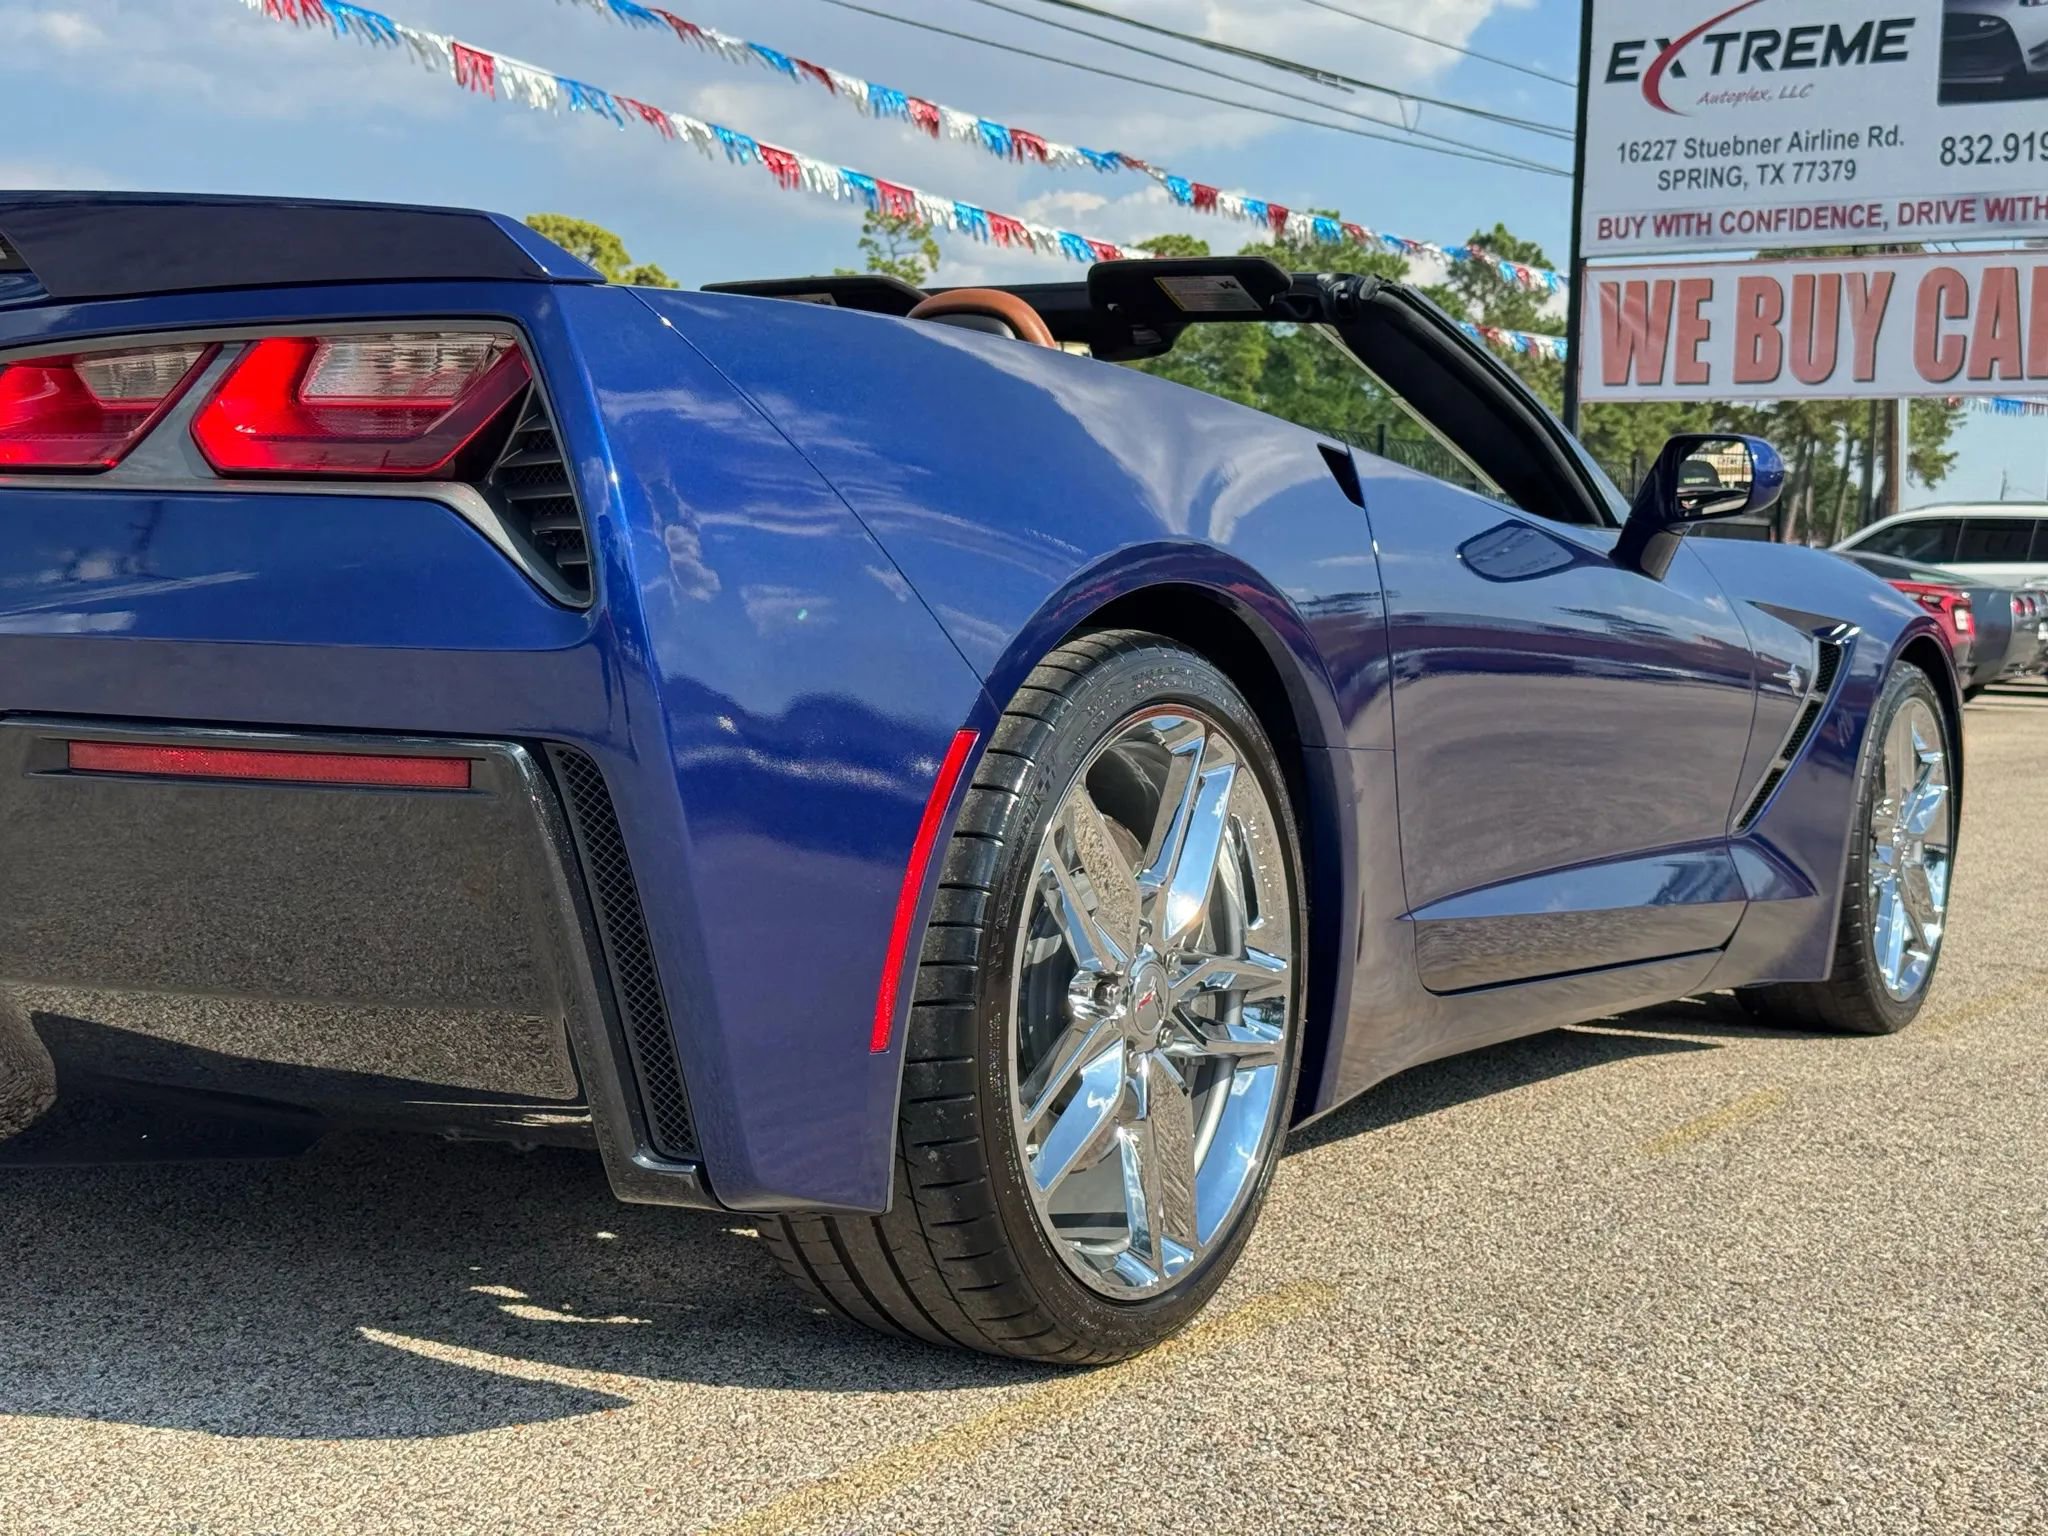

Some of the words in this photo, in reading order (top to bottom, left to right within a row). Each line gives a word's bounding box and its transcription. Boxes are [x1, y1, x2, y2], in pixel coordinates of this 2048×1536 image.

[1604, 17, 1917, 84] EXTREME
[1696, 85, 1773, 108] Autoplex,
[1778, 83, 1815, 99] LLC
[1617, 139, 1677, 164] 16227
[1683, 136, 1783, 160] Stuebner
[1786, 128, 1861, 153] Airline
[1867, 125, 1905, 148] Rd.
[1657, 166, 1749, 191] SPRING,
[1757, 163, 1785, 186] TX
[1792, 159, 1857, 184] 77379
[1598, 216, 1647, 241] BUY
[1653, 212, 1713, 238] WITH
[1719, 203, 1889, 234] CONFIDENCE,
[1897, 198, 1975, 227] DRIVE
[1983, 195, 2048, 223] WITH
[1598, 278, 1713, 386] WE
[1732, 271, 1895, 385] BUY
